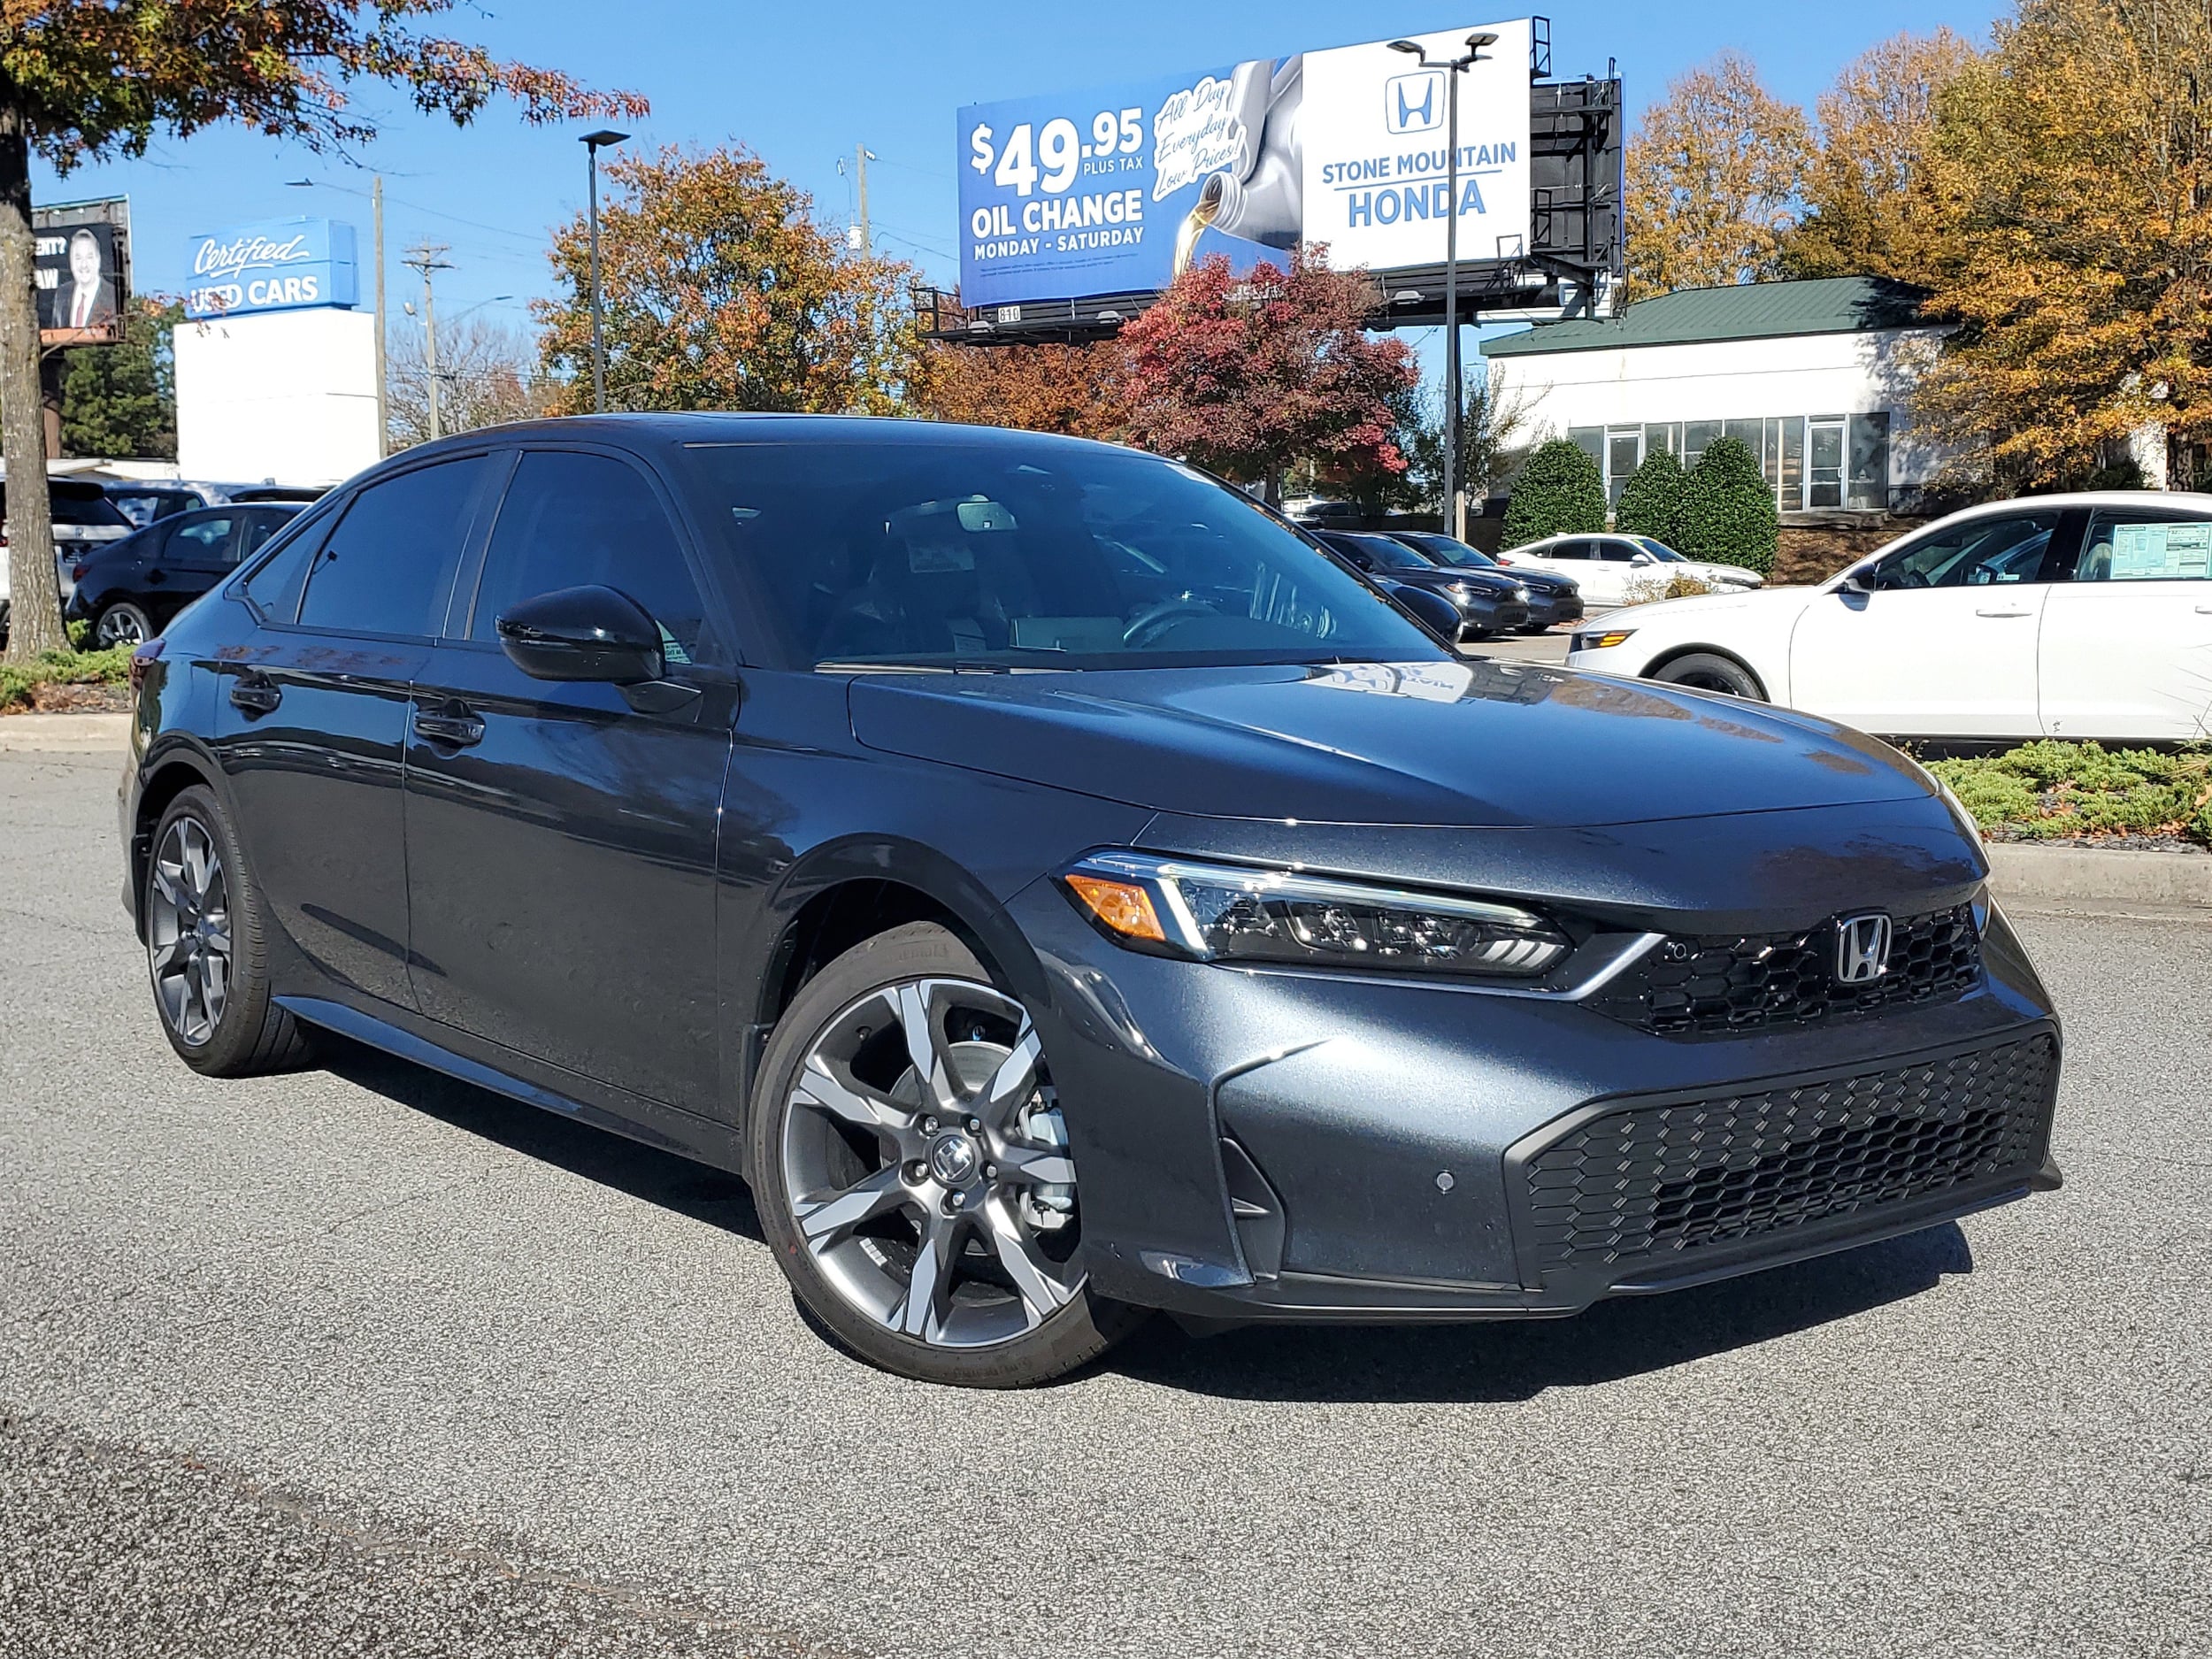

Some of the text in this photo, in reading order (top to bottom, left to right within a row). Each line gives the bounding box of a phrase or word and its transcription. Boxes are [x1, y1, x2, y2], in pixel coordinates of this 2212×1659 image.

[1158, 82, 1228, 132] All Day
[1158, 114, 1229, 164] Everyday
[1083, 155, 1144, 176] PLUS TAX
[1156, 131, 1242, 196] Low Prices!
[1322, 156, 1391, 184] STONE
[972, 188, 1144, 240] OIL CHANGE
[1348, 179, 1487, 228] HONDA
[193, 234, 311, 280] Certified
[974, 237, 1041, 261] MONDAY
[1056, 227, 1145, 252] SATURDAY
[247, 275, 319, 306] CARS
